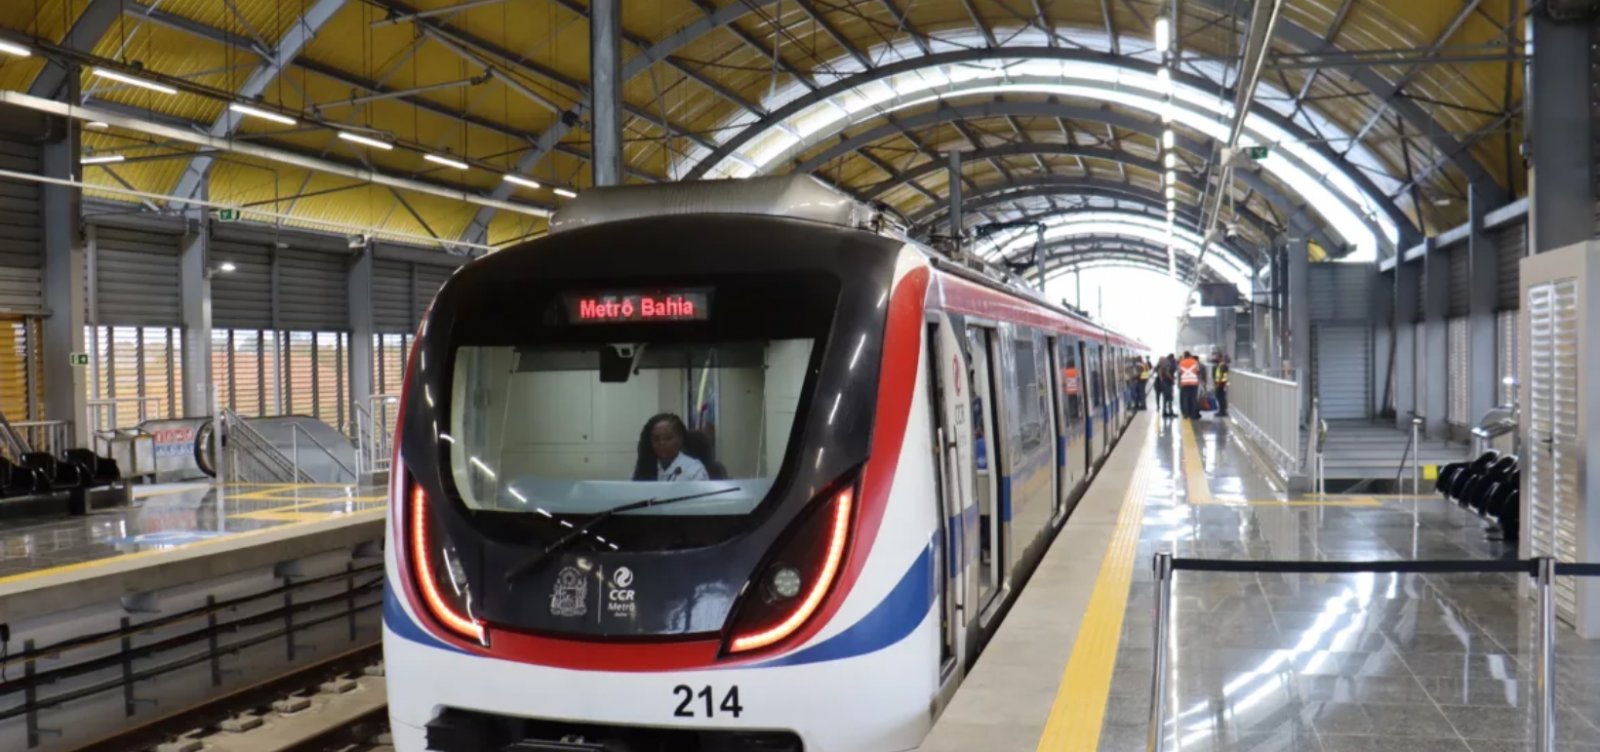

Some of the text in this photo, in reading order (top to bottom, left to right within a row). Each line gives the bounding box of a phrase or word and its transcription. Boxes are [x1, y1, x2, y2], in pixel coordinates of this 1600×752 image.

[579, 296, 694, 319] Metrô Bahia
[609, 588, 636, 601] CCR
[673, 684, 743, 718] 214
